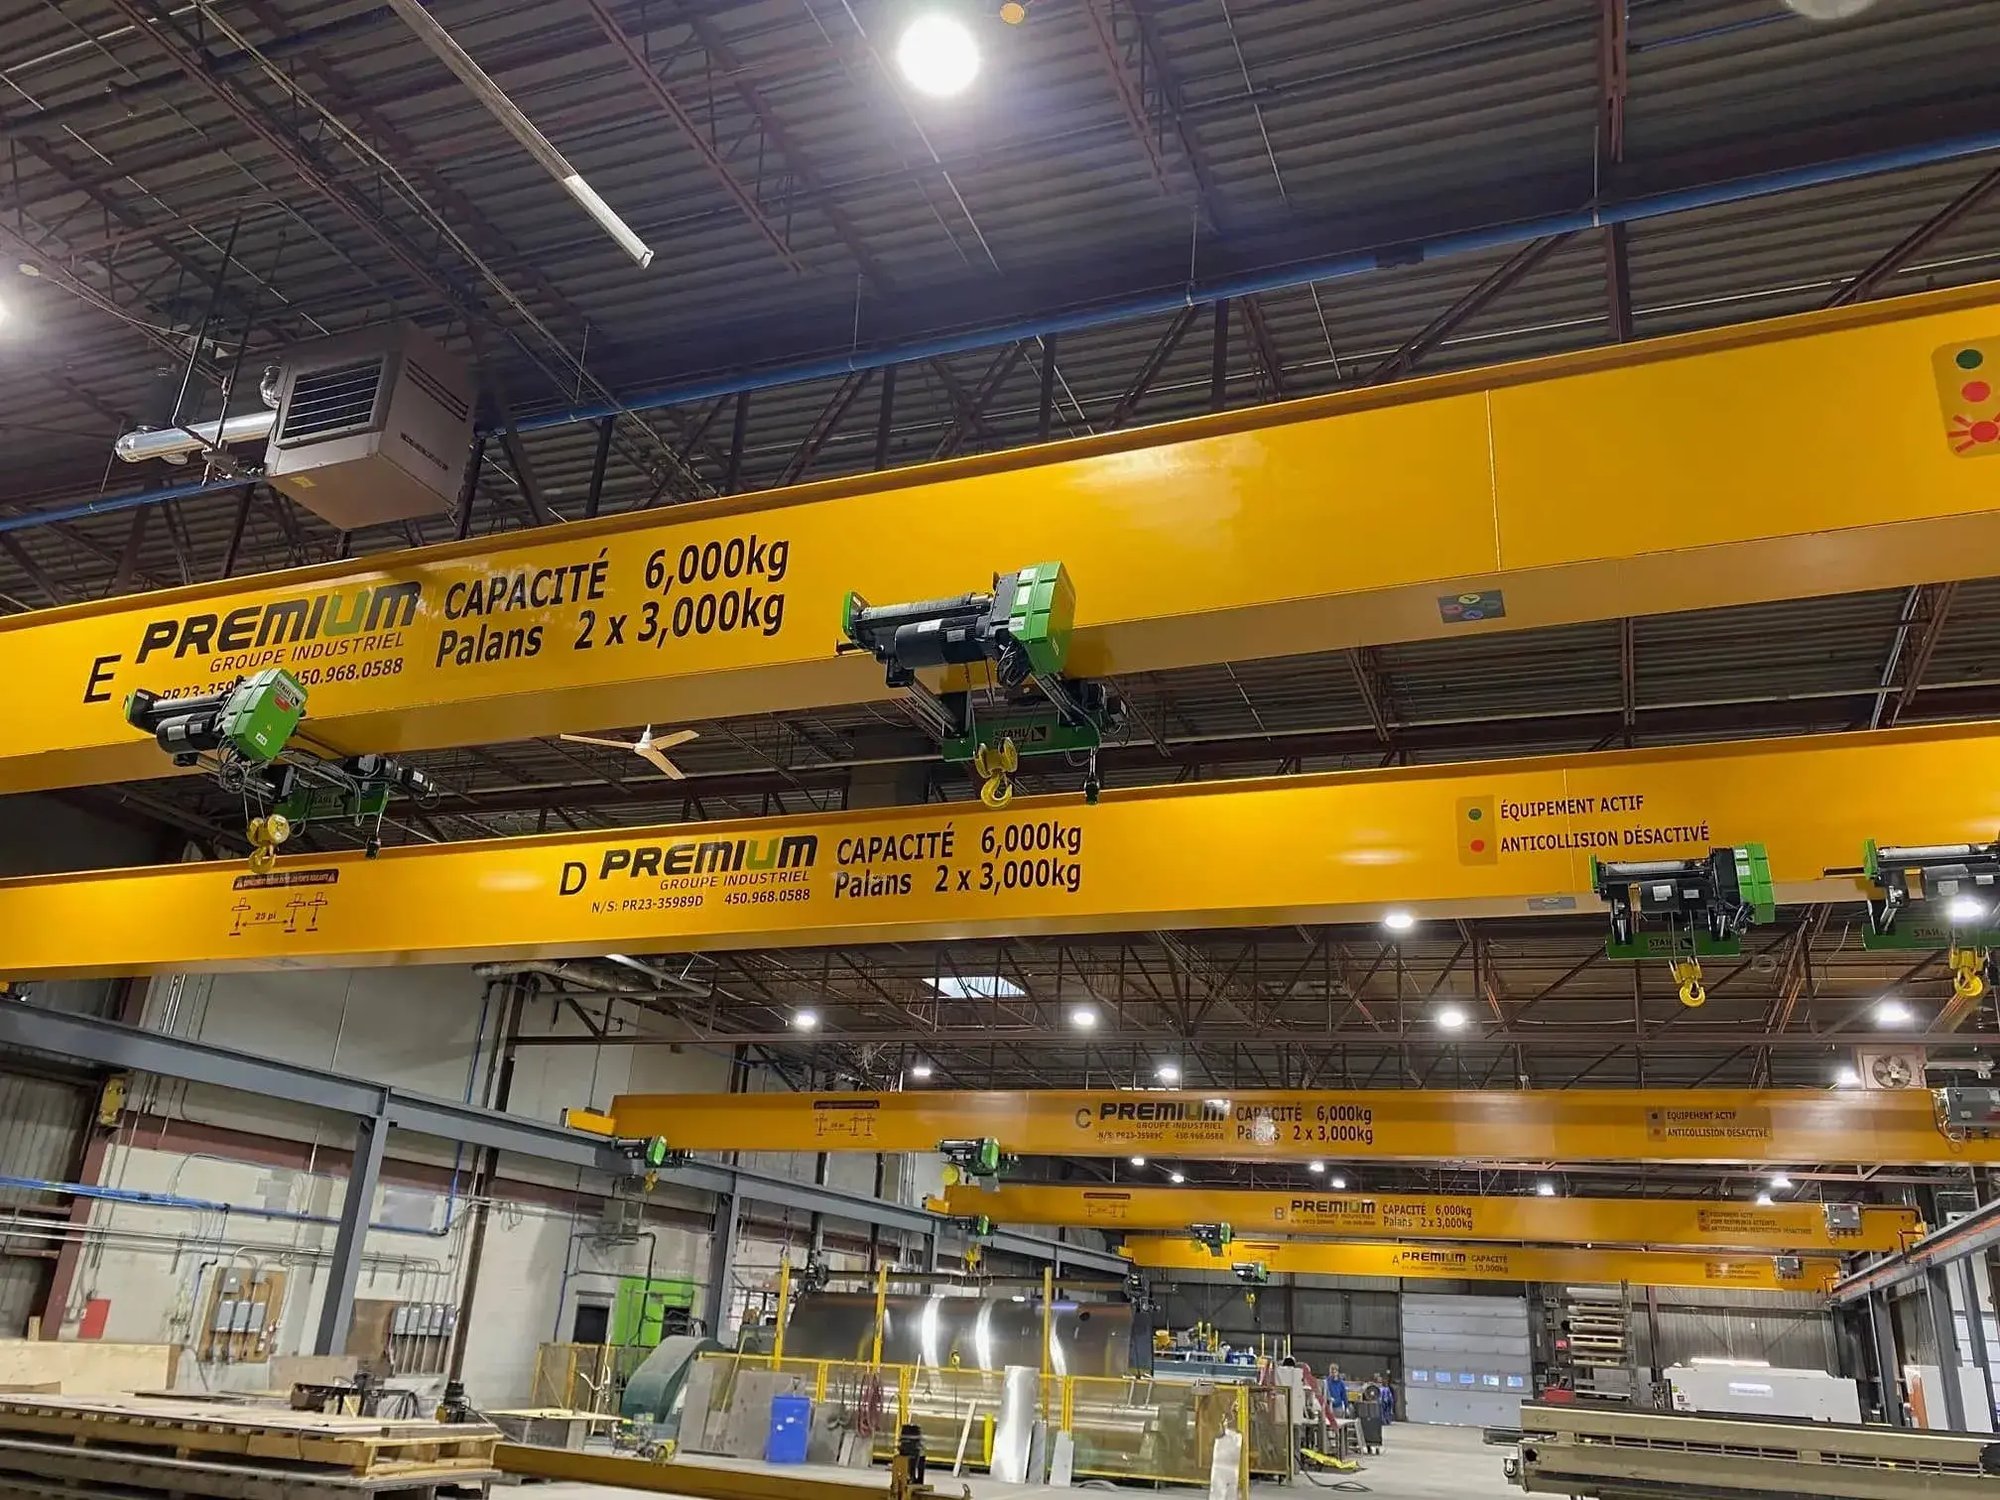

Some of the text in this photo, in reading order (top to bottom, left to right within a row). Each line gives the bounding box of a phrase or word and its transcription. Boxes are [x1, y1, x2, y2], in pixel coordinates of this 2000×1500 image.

[444, 534, 789, 620] CAPACITÉ 6,000kg
[135, 581, 422, 664] PREMIUM
[436, 587, 784, 668] Palans 2 x 3,000kg
[210, 632, 405, 673] GROUPE INDUSTRIEL
[83, 654, 121, 703] E
[1501, 795, 1644, 821] ÉQUIPEMENT ACTIF
[837, 821, 1081, 865] CAPACITÉ 6,000kg
[1501, 820, 1709, 852] ANTICOLLISION DÉSACTIVÉ
[599, 834, 818, 880] PREMIUM
[559, 861, 587, 896] D
[660, 871, 810, 891] GROUPE INDUSTRIEL
[834, 858, 1081, 899] Palans 2 x 3,000kg
[591, 889, 811, 914] N/S: PR23-35989D 450.968.0588
[1076, 1108, 1091, 1128] C
[1100, 1103, 1225, 1121] PREMIUM
[1236, 1102, 1372, 1124] CAPACITÉ 6,000kg
[1294, 1126, 1301, 1140] 2
[1306, 1128, 1313, 1140] x
[1317, 1126, 1373, 1144] 3,000kg
[1667, 1128, 1725, 1137] ANTICOLLISION
[1291, 1200, 1376, 1214] PREMIUM
[1382, 1203, 1472, 1218] CAPACITÉ 6,000kg
[1384, 1216, 1413, 1227] Palans
[1421, 1218, 1427, 1227] 2
[1437, 1218, 1473, 1230] 3,000kg
[1402, 1252, 1466, 1263] PREMIUM
